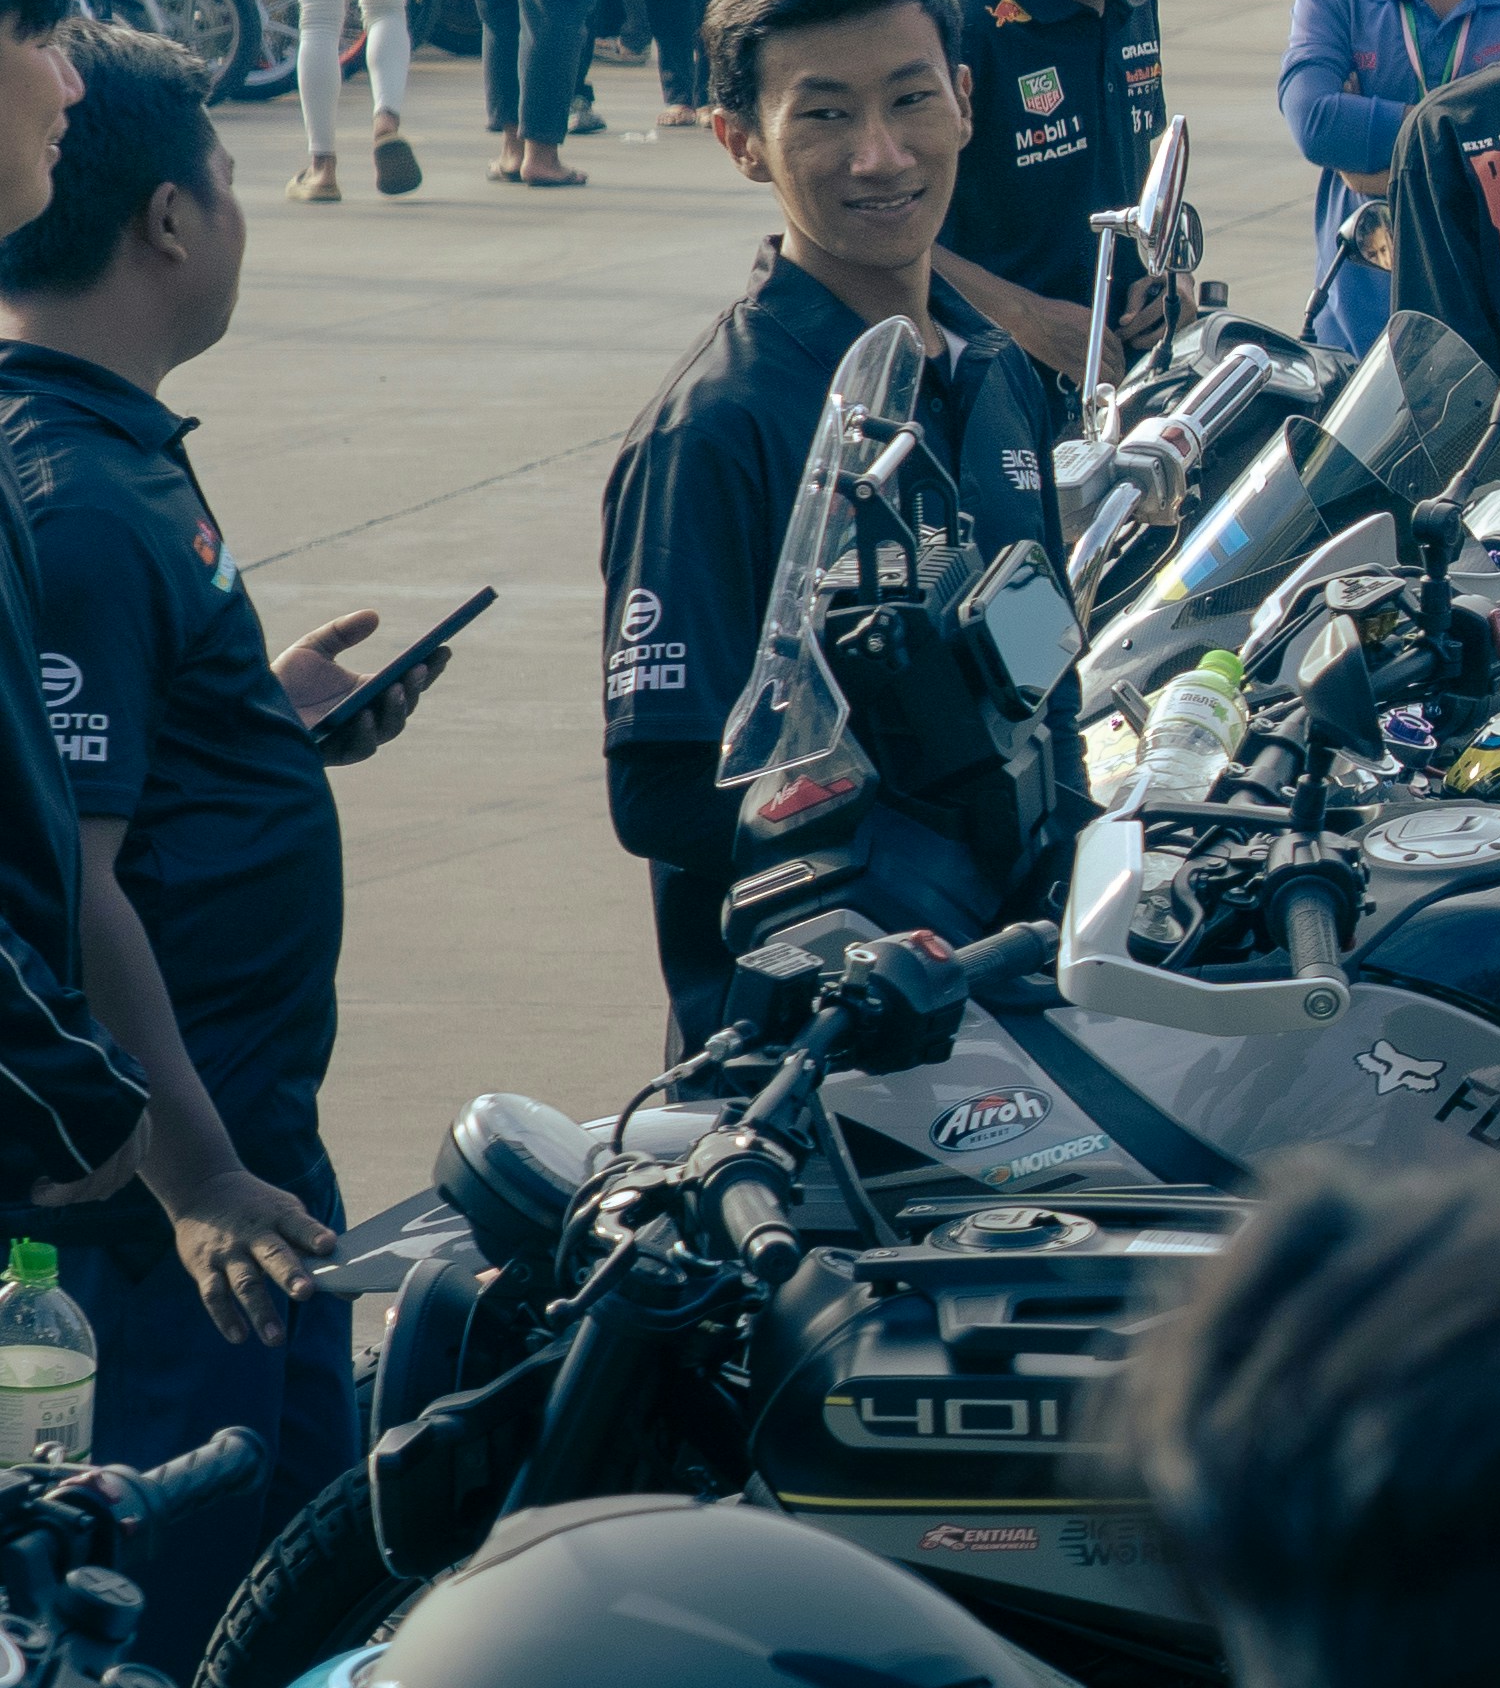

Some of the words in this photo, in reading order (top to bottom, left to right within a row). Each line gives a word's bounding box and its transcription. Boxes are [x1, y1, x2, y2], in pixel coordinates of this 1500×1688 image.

[1026, 74, 1053, 94] TAG
[1026, 90, 1061, 113] HEUER
[1015, 118, 1067, 151] Mobil
[1071, 115, 1081, 133] 1
[1016, 137, 1089, 168] ORACLE
[937, 1091, 1044, 1144] Airoh
[1010, 1134, 1106, 1178] MOTOREX
[861, 1397, 1060, 1436] 401
